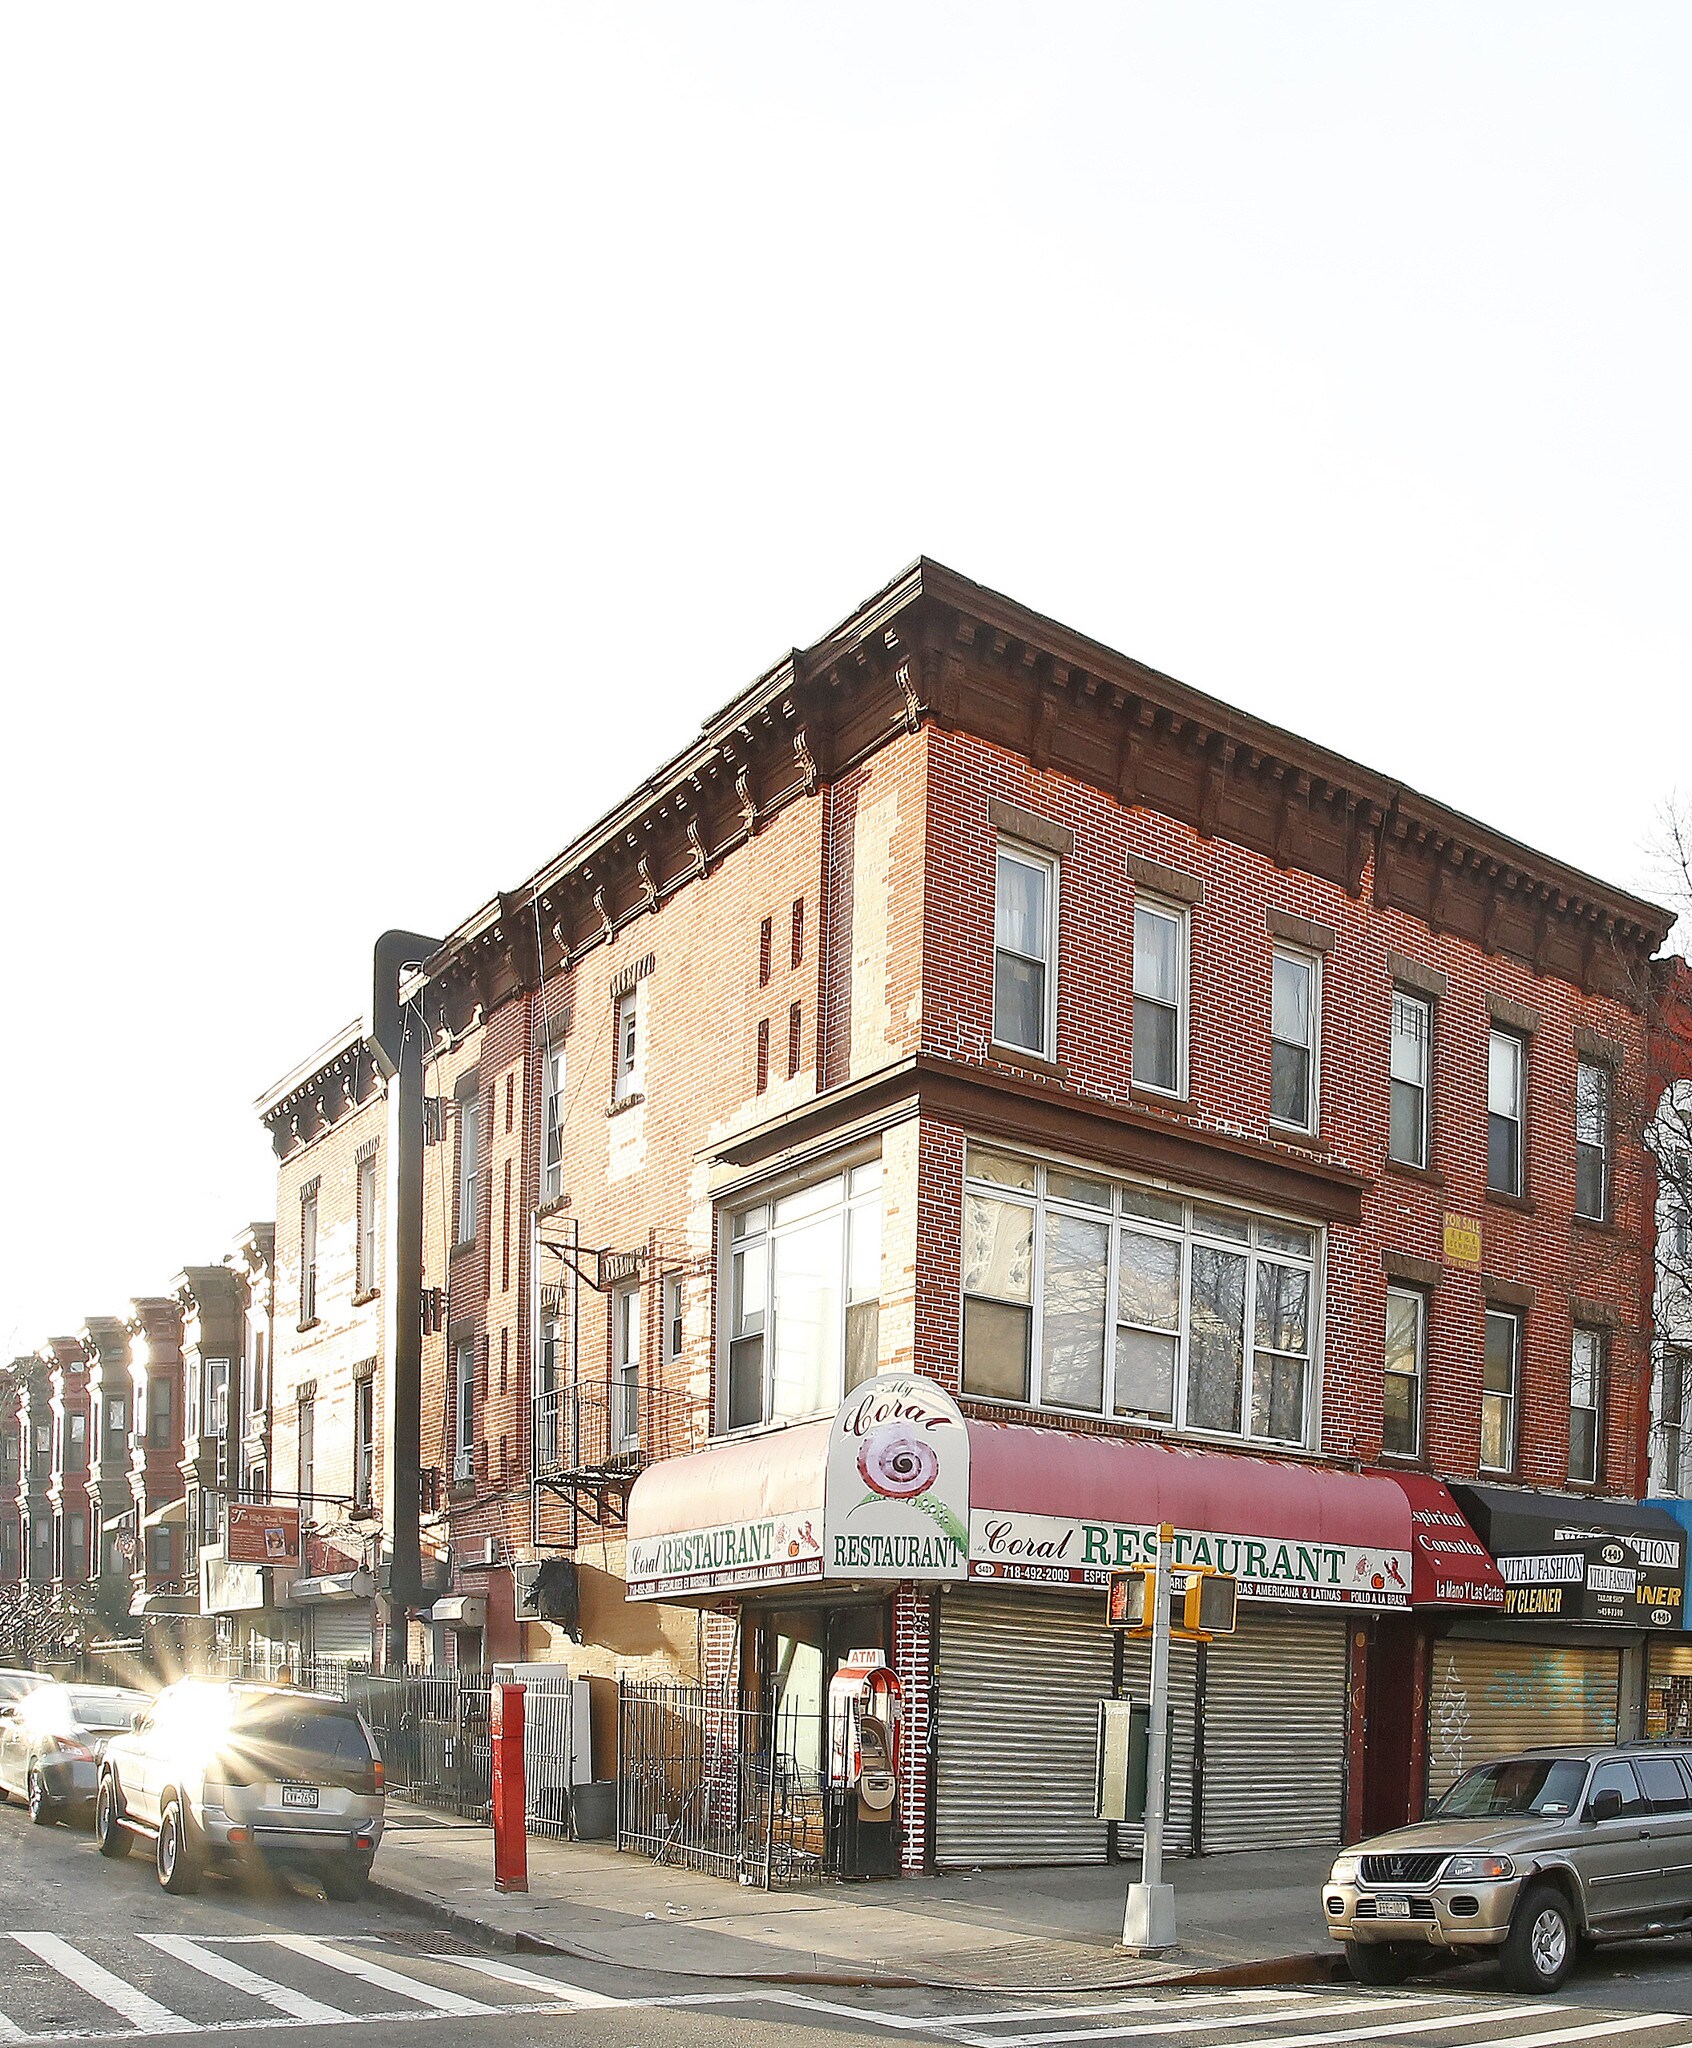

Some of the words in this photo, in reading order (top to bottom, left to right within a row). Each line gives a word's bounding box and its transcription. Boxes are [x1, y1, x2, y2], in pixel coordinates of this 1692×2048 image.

[1463, 1217, 1480, 1233] SALE
[882, 1380, 914, 1398] My
[843, 1394, 953, 1437] Coral
[631, 1544, 661, 1575] Coral
[662, 1522, 775, 1574] RESTAURANT
[833, 1535, 961, 1568] RESTAURANT
[985, 1520, 1074, 1559] Coral
[1081, 1524, 1345, 1584] RESTAURANT
[1418, 1534, 1485, 1557] Consulta
[1504, 1558, 1535, 1582] VITAL
[1537, 1556, 1583, 1581] FASHION
[1002, 1564, 1070, 1582] 718-492-2009
[1255, 1584, 1300, 1599] AMERICANA
[1301, 1588, 1309, 1600] &
[1310, 1588, 1341, 1602] LATINAS
[1350, 1591, 1371, 1604] POLLO
[1372, 1593, 1377, 1604] A
[1378, 1593, 1386, 1605] LA
[1387, 1594, 1407, 1606] BRASA
[1436, 1580, 1445, 1598] La
[1446, 1580, 1464, 1599] Mano
[1465, 1581, 1471, 1599] Y
[1471, 1582, 1483, 1600] Las
[1483, 1583, 1504, 1602] Cartas
[1504, 1589, 1516, 1614] RY
[1517, 1588, 1562, 1613] CLEANER
[851, 1651, 876, 1663] ATM
